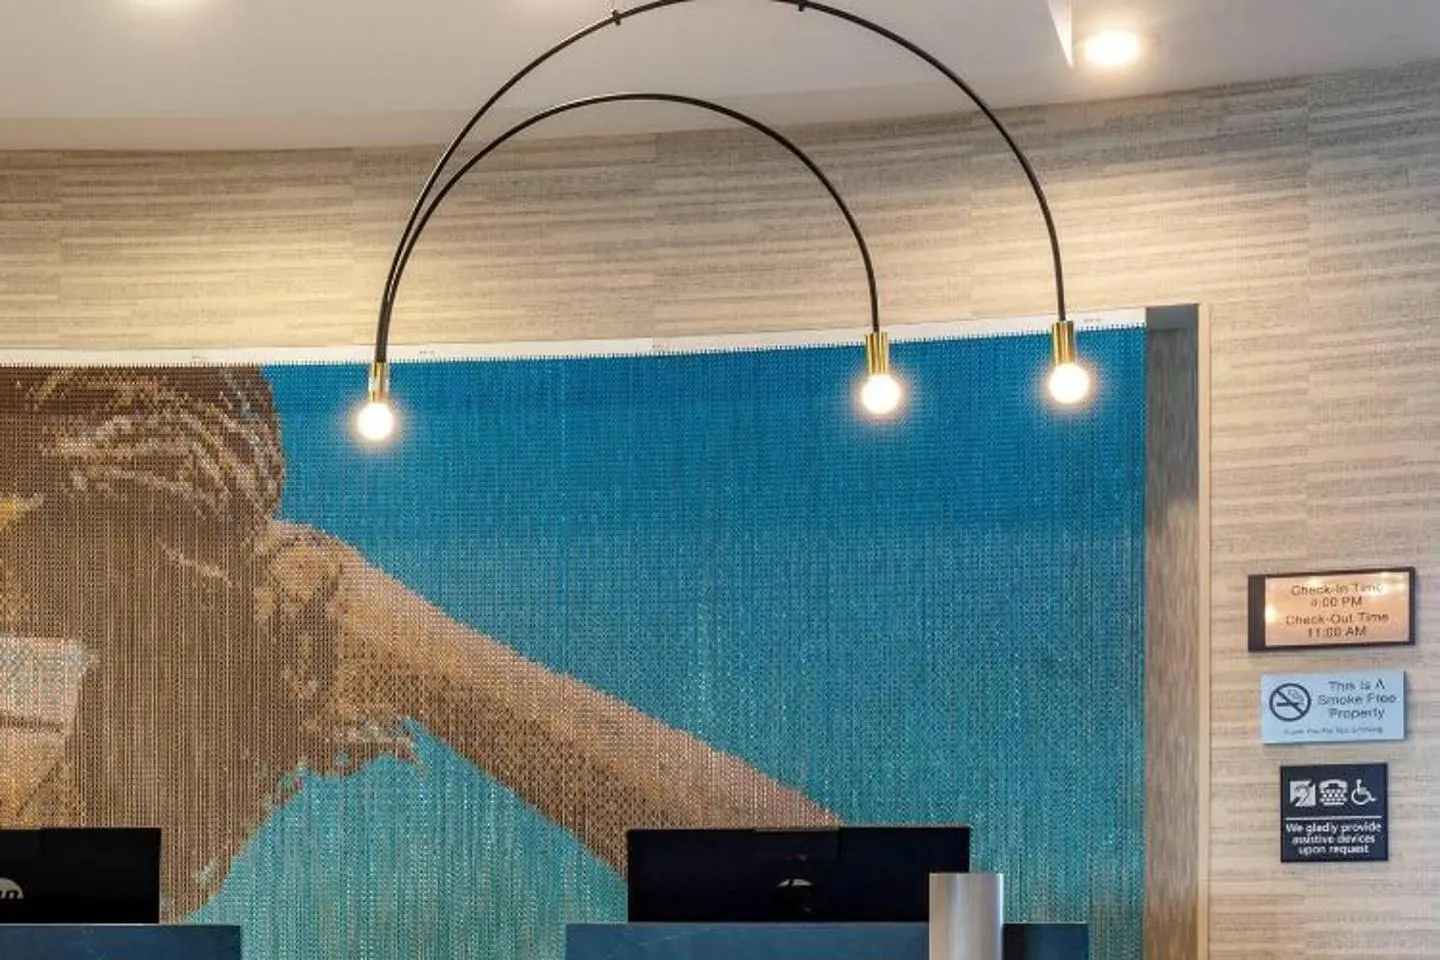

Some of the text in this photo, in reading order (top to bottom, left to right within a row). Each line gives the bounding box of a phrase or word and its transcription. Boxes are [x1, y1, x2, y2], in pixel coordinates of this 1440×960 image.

[1342, 595, 1363, 607] PM
[1285, 612, 1389, 625] Check-Out Time
[1345, 626, 1367, 637] AM
[1328, 680, 1356, 691] This
[1374, 678, 1386, 690] A
[1317, 692, 1397, 706] Smoke Free
[1328, 708, 1386, 720] Property
[1285, 821, 1382, 836] We gladly provide
[1291, 833, 1376, 845] assistive devices
[1298, 845, 1370, 856] upon request
